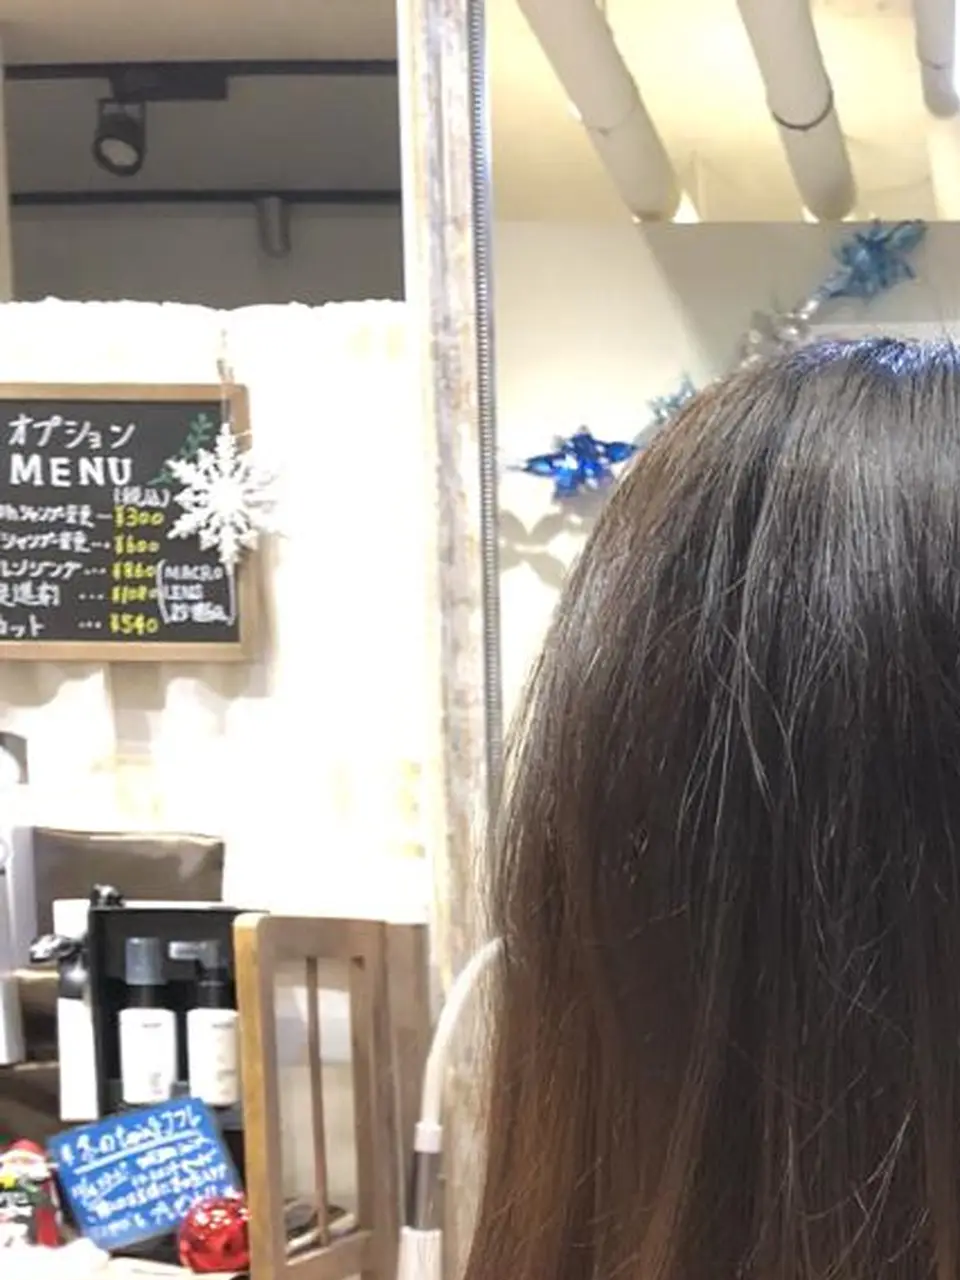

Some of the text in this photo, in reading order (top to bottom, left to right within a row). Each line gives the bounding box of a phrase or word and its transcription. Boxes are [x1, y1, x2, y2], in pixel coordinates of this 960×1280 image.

[8, 412, 136, 450] オプション
[10, 453, 133, 488] MENU
[108, 611, 159, 637] ¥540
